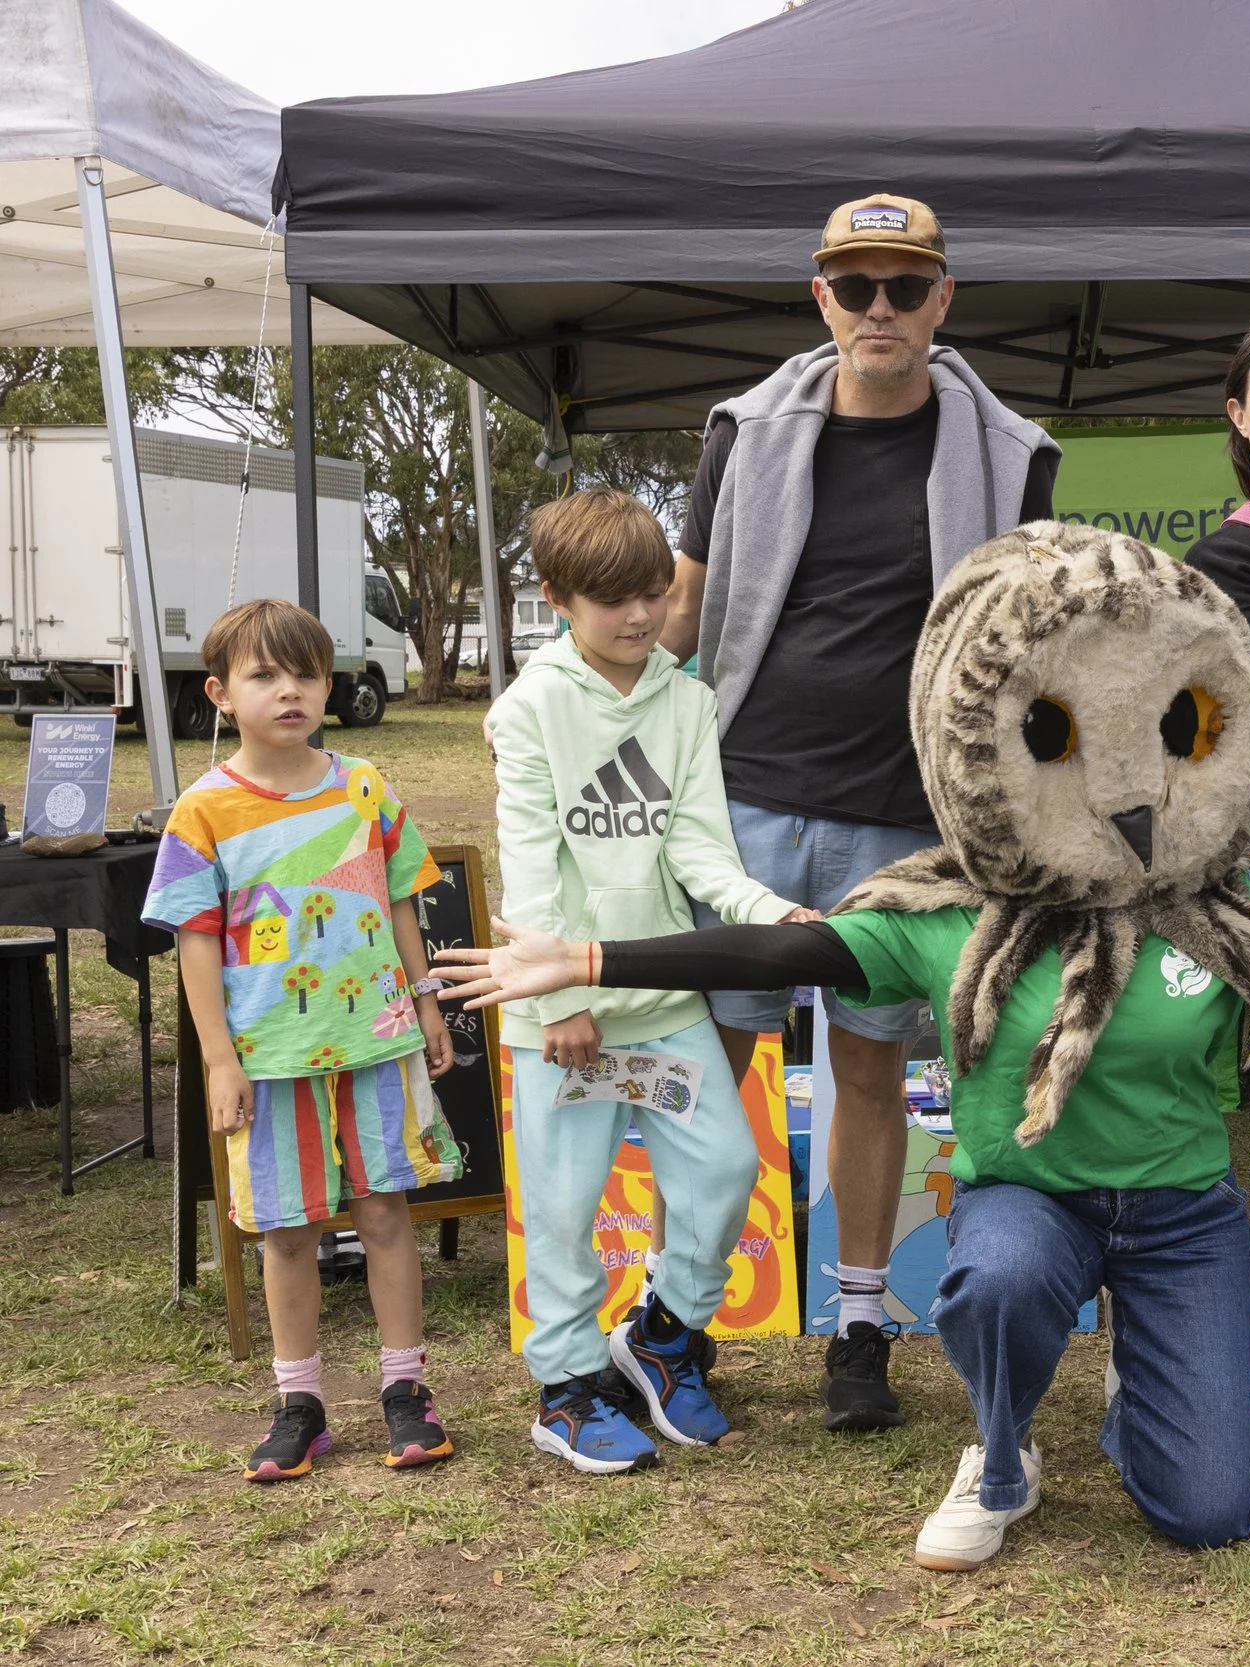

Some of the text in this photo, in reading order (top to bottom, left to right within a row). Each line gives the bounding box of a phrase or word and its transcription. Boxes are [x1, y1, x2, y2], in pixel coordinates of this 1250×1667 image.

[854, 219, 903, 229] patagonia
[73, 732, 101, 741] Energy
[565, 801, 670, 839] adida
[45, 825, 81, 837] SCAN ME
[441, 1012, 477, 1032] ERS
[593, 1211, 652, 1233] EAMING
